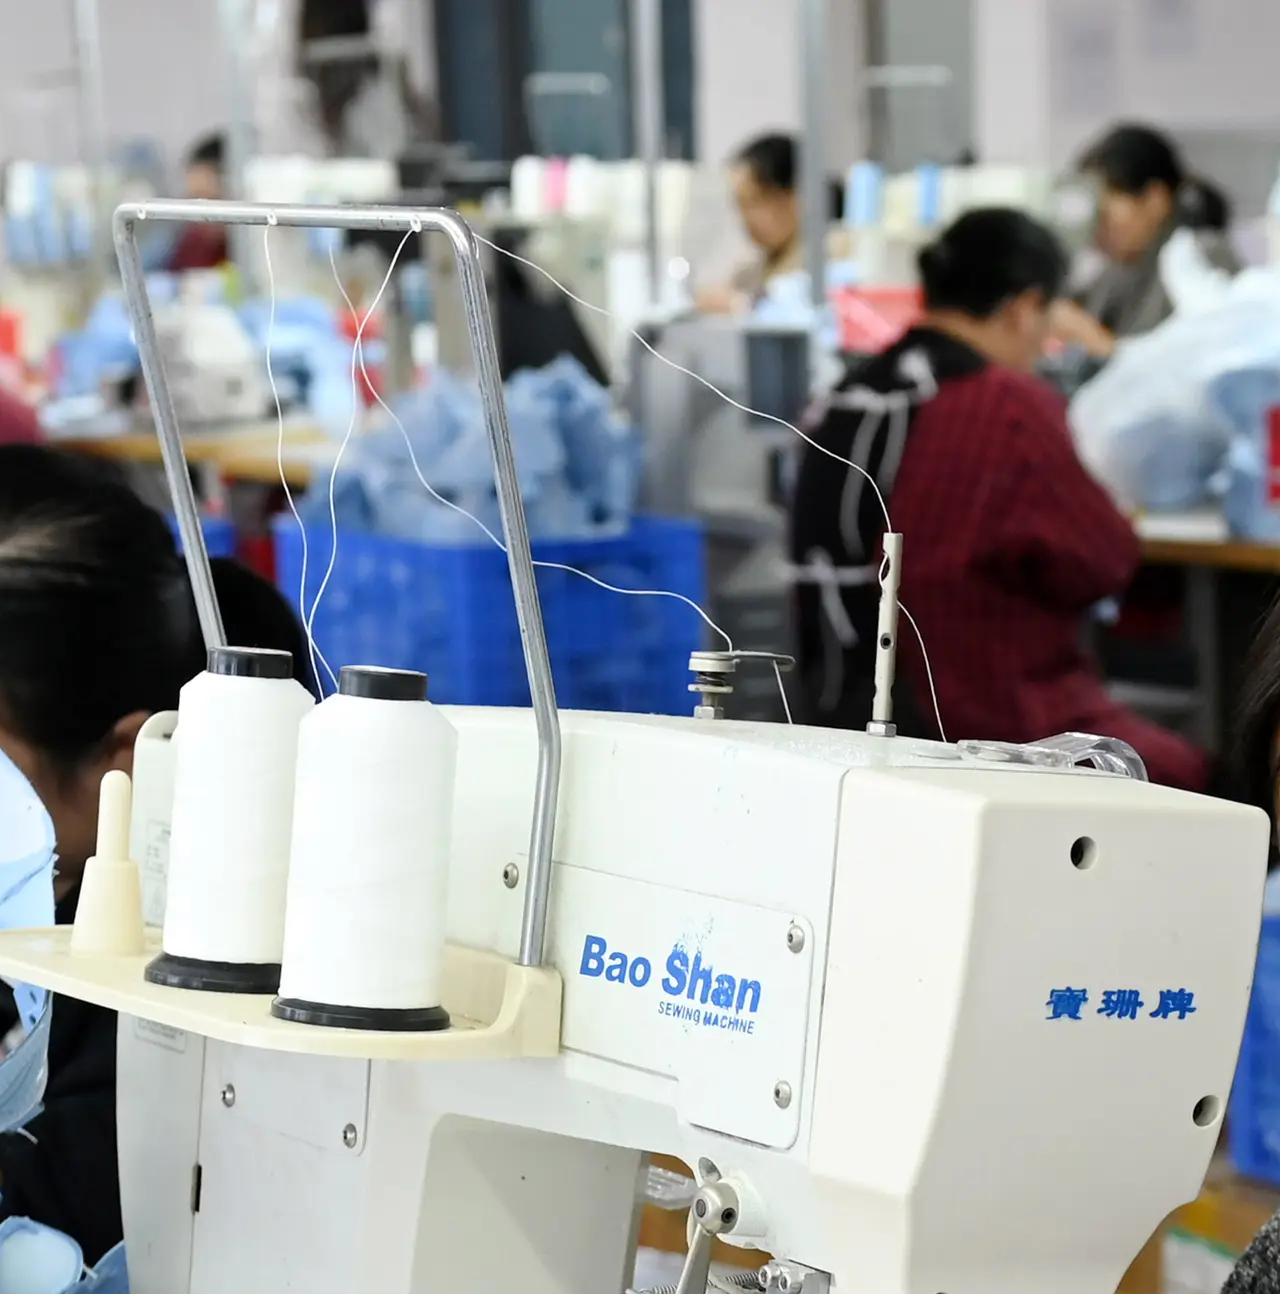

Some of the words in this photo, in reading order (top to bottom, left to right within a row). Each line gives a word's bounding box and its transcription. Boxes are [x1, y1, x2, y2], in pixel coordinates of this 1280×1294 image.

[579, 934, 652, 988] Bao
[661, 944, 762, 1013] Shan
[658, 1001, 701, 1025] SEWING
[702, 1011, 756, 1035] MACHINE
[1045, 986, 1197, 1020] 寶珊牌
